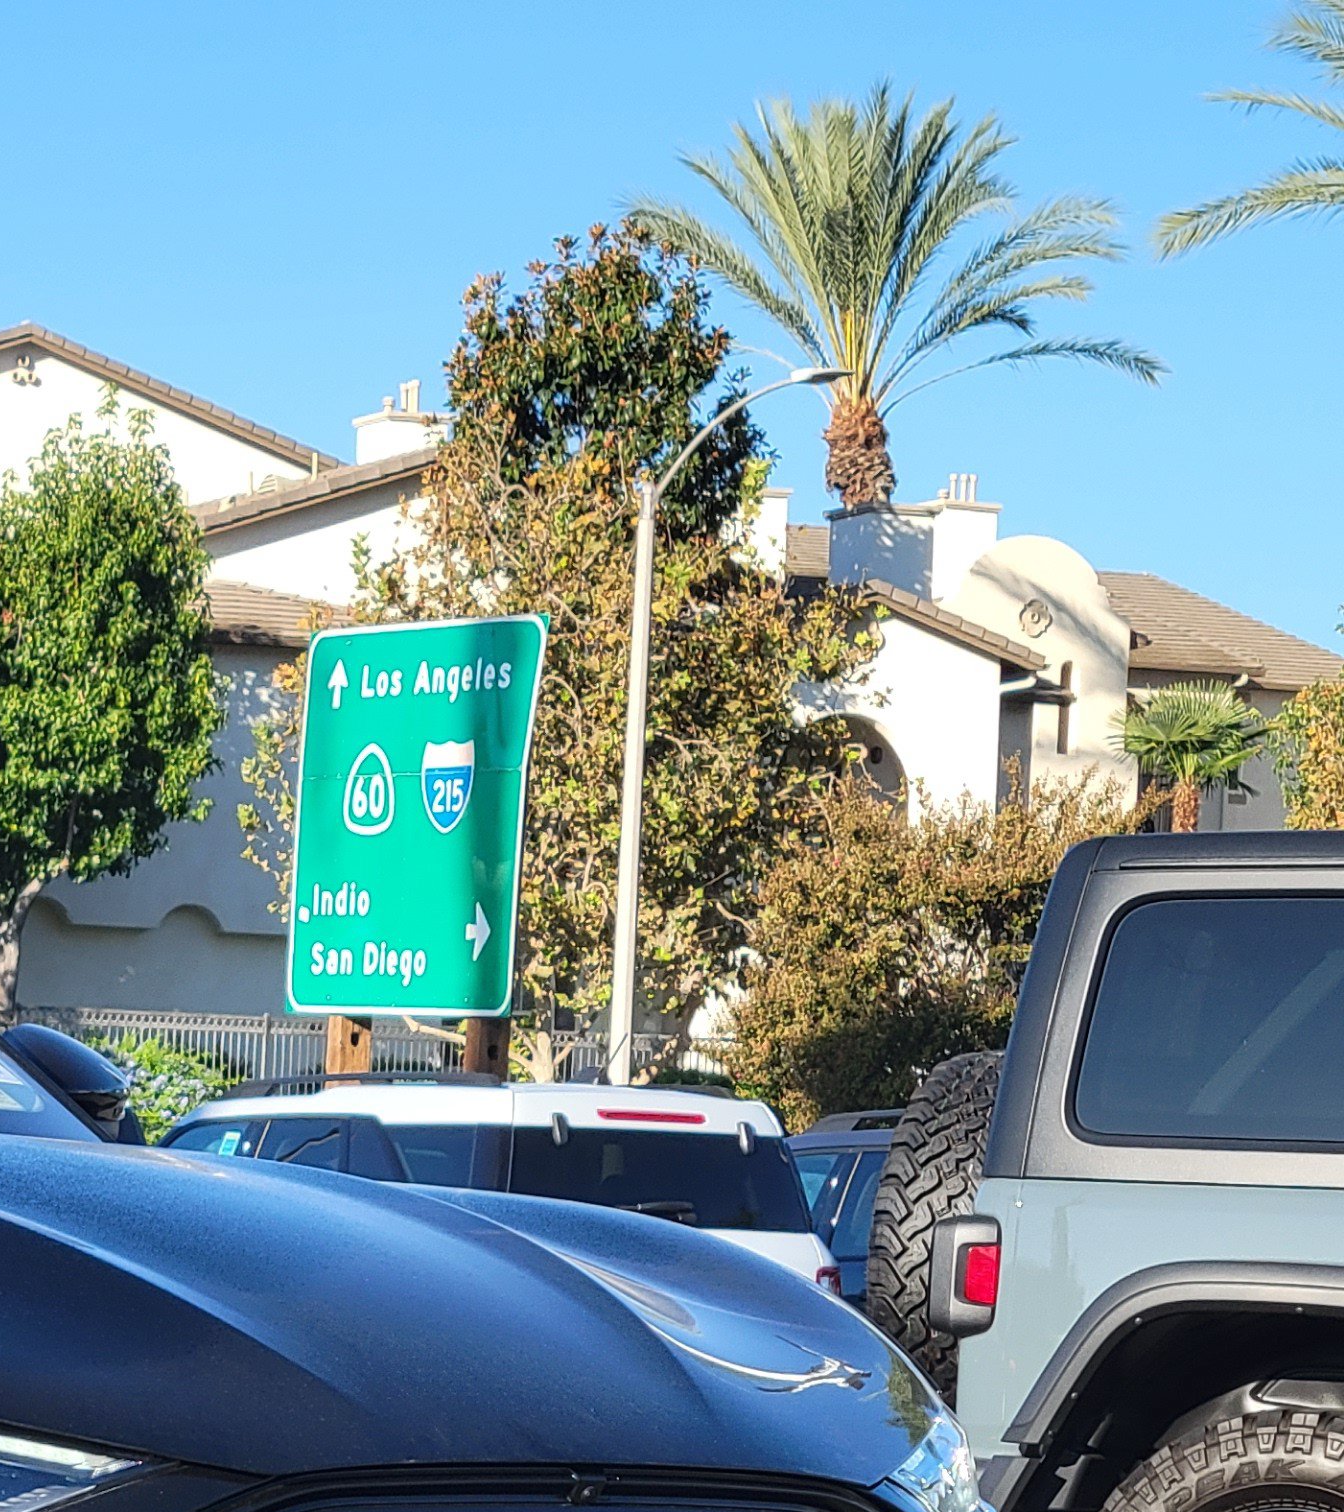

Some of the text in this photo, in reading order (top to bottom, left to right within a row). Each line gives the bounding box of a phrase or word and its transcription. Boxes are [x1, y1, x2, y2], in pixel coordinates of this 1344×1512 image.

[360, 657, 513, 704] Los Angeles
[351, 773, 385, 820] 60
[431, 778, 466, 815] 215
[311, 881, 371, 918] Indio
[309, 942, 428, 988] San Diego
